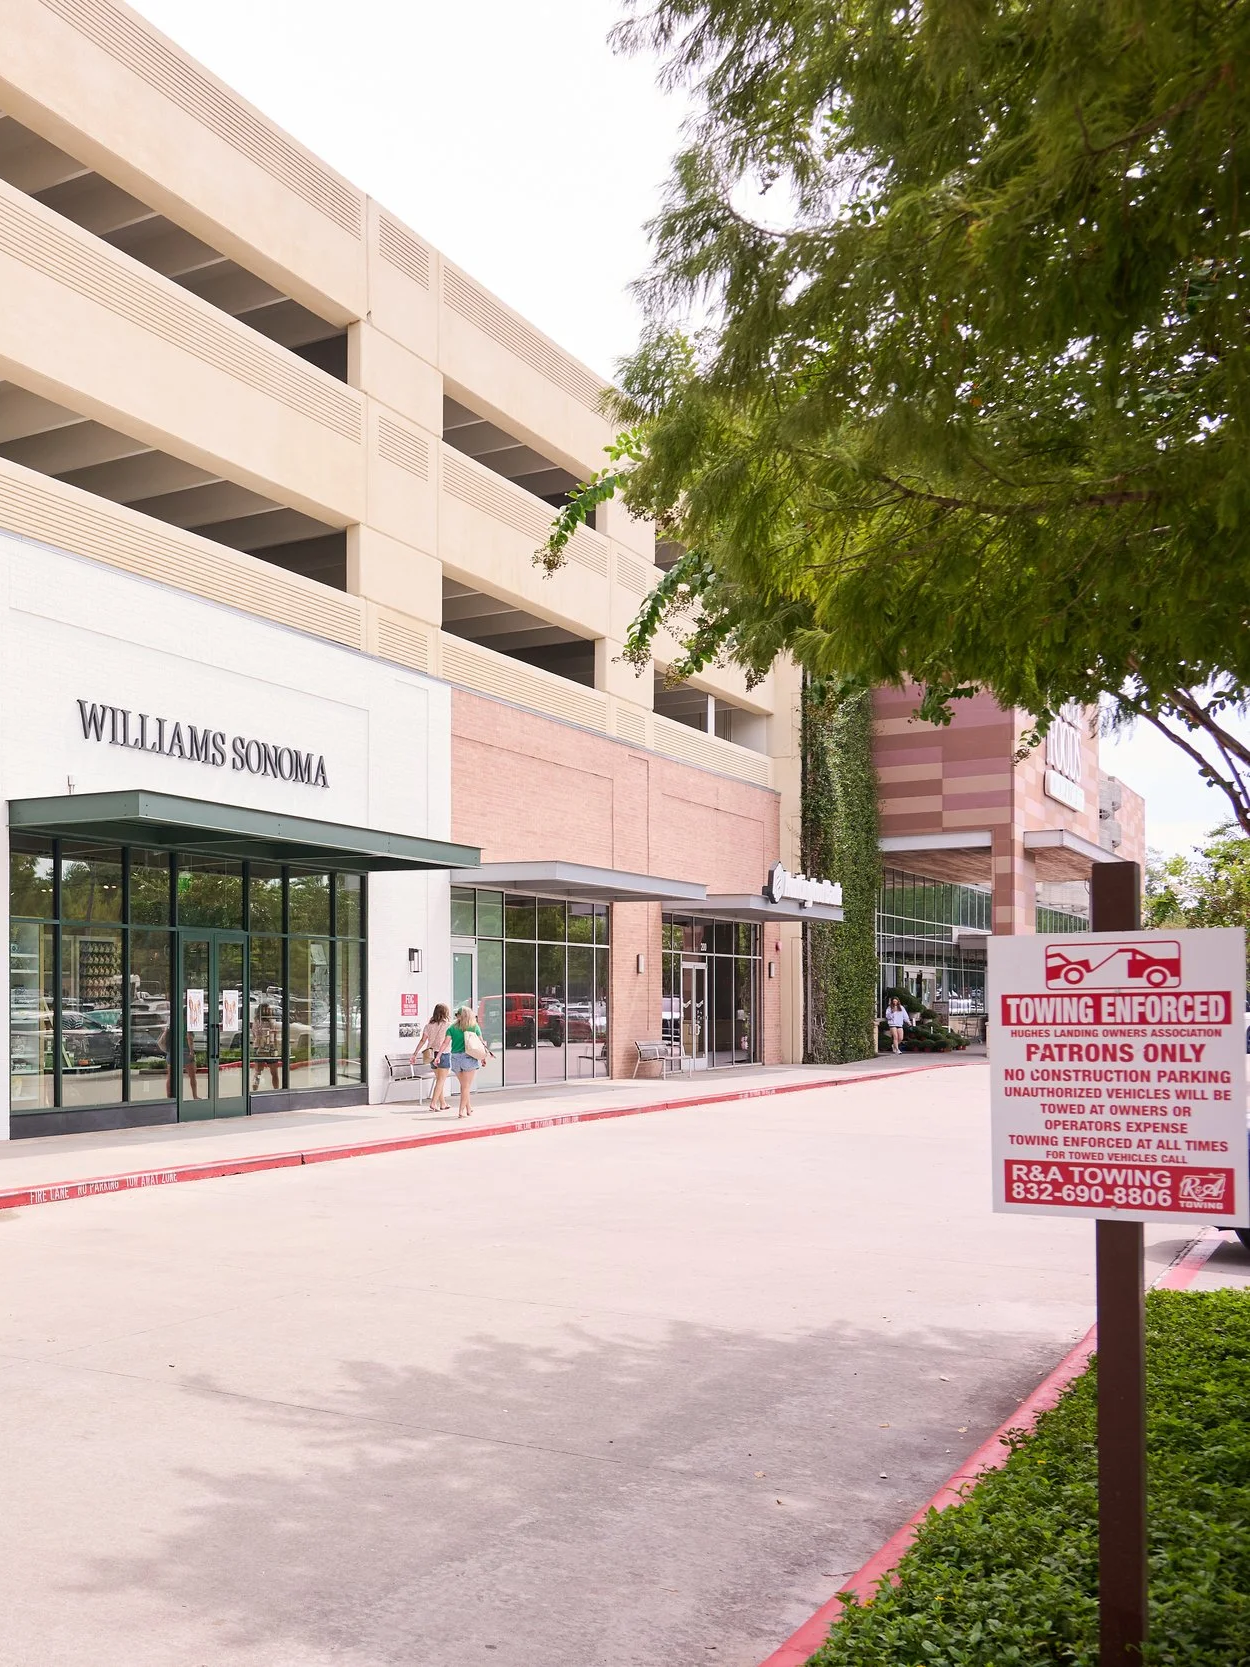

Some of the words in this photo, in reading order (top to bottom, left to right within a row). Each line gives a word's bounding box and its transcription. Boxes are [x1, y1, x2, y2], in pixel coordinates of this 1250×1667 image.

[76, 699, 226, 767] WILLIAMS
[232, 735, 331, 789] SONOMA
[1006, 996, 1094, 1024] TOWING
[1101, 995, 1225, 1023] ENFORCED
[1010, 1029, 1051, 1038] HUGHES
[1054, 1029, 1099, 1038] LANDING
[1102, 1028, 1147, 1038] OWNERS
[1150, 1028, 1222, 1038] ASSOCIATION
[1025, 1043, 1135, 1062] PATRONS
[1143, 1043, 1206, 1063] ONLY
[1004, 1069, 1025, 1081] NO
[1031, 1069, 1151, 1083] CONSTRUCTION
[1157, 1070, 1231, 1084] PARKING
[1004, 1087, 1103, 1099] UNAUTHORIZED
[1106, 1088, 1171, 1100] VEHICLES
[1175, 1089, 1208, 1100] WILL
[1213, 1090, 1232, 1101] BE
[1040, 1103, 1085, 1115] TOWED
[1089, 1104, 1106, 1115] AT
[1109, 1105, 1168, 1117] OWNERS
[1173, 1106, 1192, 1117] OR
[1044, 1119, 1121, 1132] OPERATORS
[1126, 1121, 1188, 1134] EXPENSE
[1008, 1135, 1059, 1147] TOWING
[1063, 1137, 1132, 1149] ENFORCED
[1136, 1139, 1152, 1150] AT
[1156, 1140, 1181, 1151] ALL
[1185, 1140, 1229, 1152] TIMES
[1045, 1151, 1065, 1160] FOR
[1069, 1152, 1104, 1161] TOWED
[1107, 1153, 1157, 1163] VEHICLES
[1161, 1154, 1188, 1164] CALL
[1011, 1165, 1064, 1183] R&A
[1068, 1166, 1172, 1187] TOWING
[29, 1191, 47, 1204] FIRE
[50, 1188, 70, 1201] LANE
[89, 1180, 119, 1194] PARKING
[1011, 1182, 1173, 1207] 832-690-8806
[1179, 1177, 1226, 1202] R&A
[1178, 1200, 1224, 1210] TOWING
